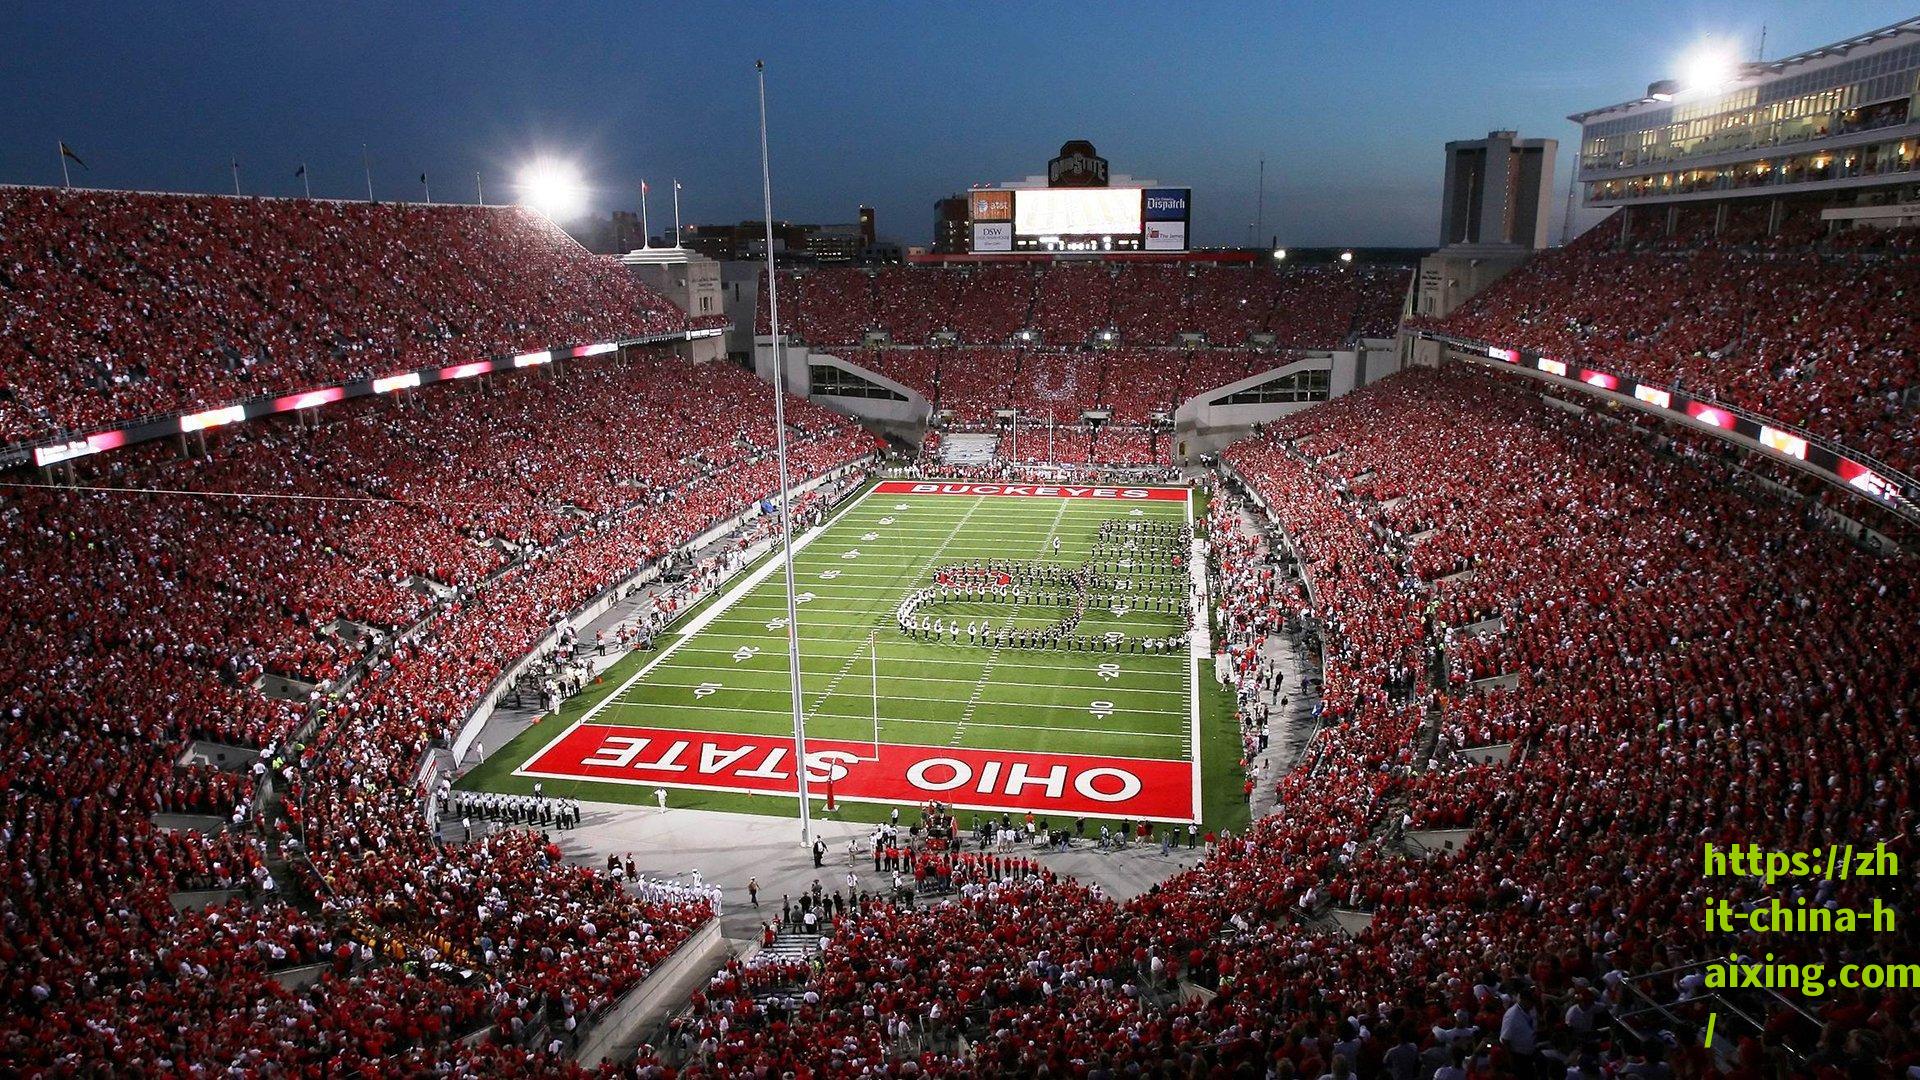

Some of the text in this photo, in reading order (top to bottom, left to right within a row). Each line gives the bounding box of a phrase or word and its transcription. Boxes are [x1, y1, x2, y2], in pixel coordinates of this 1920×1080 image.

[1147, 198, 1185, 211] Dispatch
[983, 228, 1002, 236] DSW
[911, 483, 1149, 498] BUCKEYES
[1097, 663, 1120, 677] 20
[694, 682, 723, 695] 10
[1089, 701, 1114, 715] 10
[580, 735, 1142, 802] OHIO STATE
